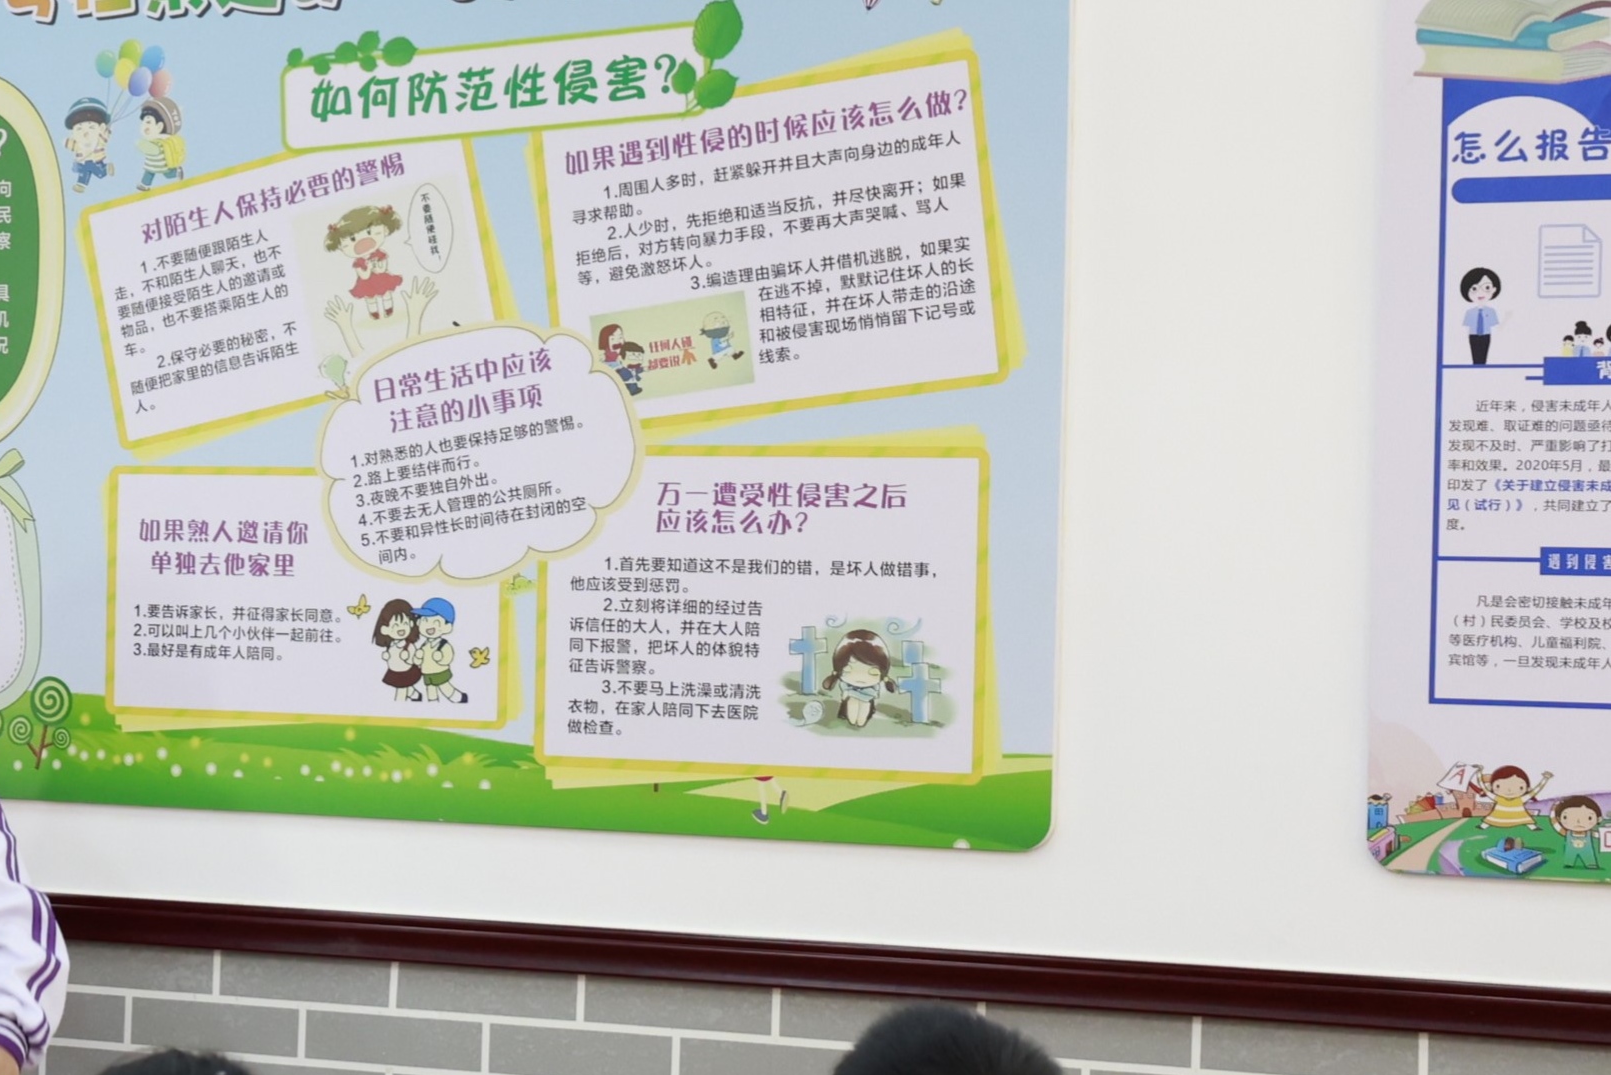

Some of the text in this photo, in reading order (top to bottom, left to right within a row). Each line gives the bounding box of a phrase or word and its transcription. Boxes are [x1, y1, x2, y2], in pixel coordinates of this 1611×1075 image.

[310, 53, 678, 123] 如何防范性侵害？
[565, 89, 968, 175] 如果遇到性侵的时候应该怎么做？
[1451, 125, 1611, 165] 怎么报告
[604, 130, 961, 200] 1.周围人多时，赶紧躲开并且大声向身边的成年人
[141, 151, 406, 245] 对陌生人保持必要的警惕
[572, 201, 644, 225] 寻求帮助。
[607, 172, 967, 241] 2.人少时，先拒绝和适当反抗，并尽快离开；如果
[576, 196, 949, 266] 拒绝后，对方转向暴力手段，不要再大声哭喊、骂人
[140, 229, 269, 275] 1.不要随便跟陌生人
[691, 237, 971, 290] 3.编造理由骗坏人并借机逃脱，如果实
[114, 246, 282, 302] 走，不和陌生人聊天，也不
[577, 255, 713, 286] 等，避免激怒坏人。
[758, 258, 974, 301] 在逃不掉，默默记住坏人的长
[117, 265, 286, 320] 要随便接受陌生人的邀请或
[759, 279, 976, 322] 相特征，并在坏人带走的沿途
[120, 284, 289, 339] 物品，也不要搭乘陌生人的
[759, 300, 976, 344] 和被侵害现场悄悄留下记号或
[124, 341, 147, 358] 车。
[157, 321, 297, 369] 2.保守必要的秘密，不
[758, 346, 801, 364] 线索。
[130, 341, 300, 396] 随便把家里的信息告诉陌生
[374, 348, 552, 402] 日常生活中应该
[134, 397, 158, 415] 人。
[390, 384, 543, 433] 注意的小事项
[351, 417, 584, 469] 1.对熟悉的人也要保持足够的警惕。
[353, 456, 480, 489] 2.路上要结伴而行。
[356, 473, 498, 508] 3.夜晚不要独自外出。
[359, 480, 562, 528] 4.不要去无人管理的公共厕所。
[656, 481, 907, 509] 万一遭受性侵害之后
[139, 518, 309, 545] 如果熟人邀请你
[361, 496, 587, 547] 5.不要和异性长时间待在封闭的空
[656, 509, 810, 535] 应该怎么办？
[1446, 518, 1466, 532] 度。
[150, 551, 295, 578] 单独去他家里
[378, 547, 416, 565] 间内。
[604, 555, 938, 578] 1.首先要知道这不是我们的错，是坏人做错事，
[570, 575, 690, 594] 他应该受到惩罚。
[134, 604, 341, 624] 1.要告诉家长，并征得家长同意。
[603, 597, 763, 617] 2.立刻将详细的经过告
[133, 623, 342, 644] 2.可以叫上几个小伙伴一起前往。
[569, 617, 761, 638] 诉信任的大人，并在大人陪
[133, 643, 283, 662] 3.最好是有成年人陪同。
[569, 637, 760, 659] 同下报警，把坏人的体貌特
[568, 657, 656, 675] 征告诉警察。
[601, 680, 761, 700] 3.不要马上洗澡或清洗
[568, 699, 759, 722] 衣物，在家人陪同下去医院
[567, 718, 623, 737] 做检查。
